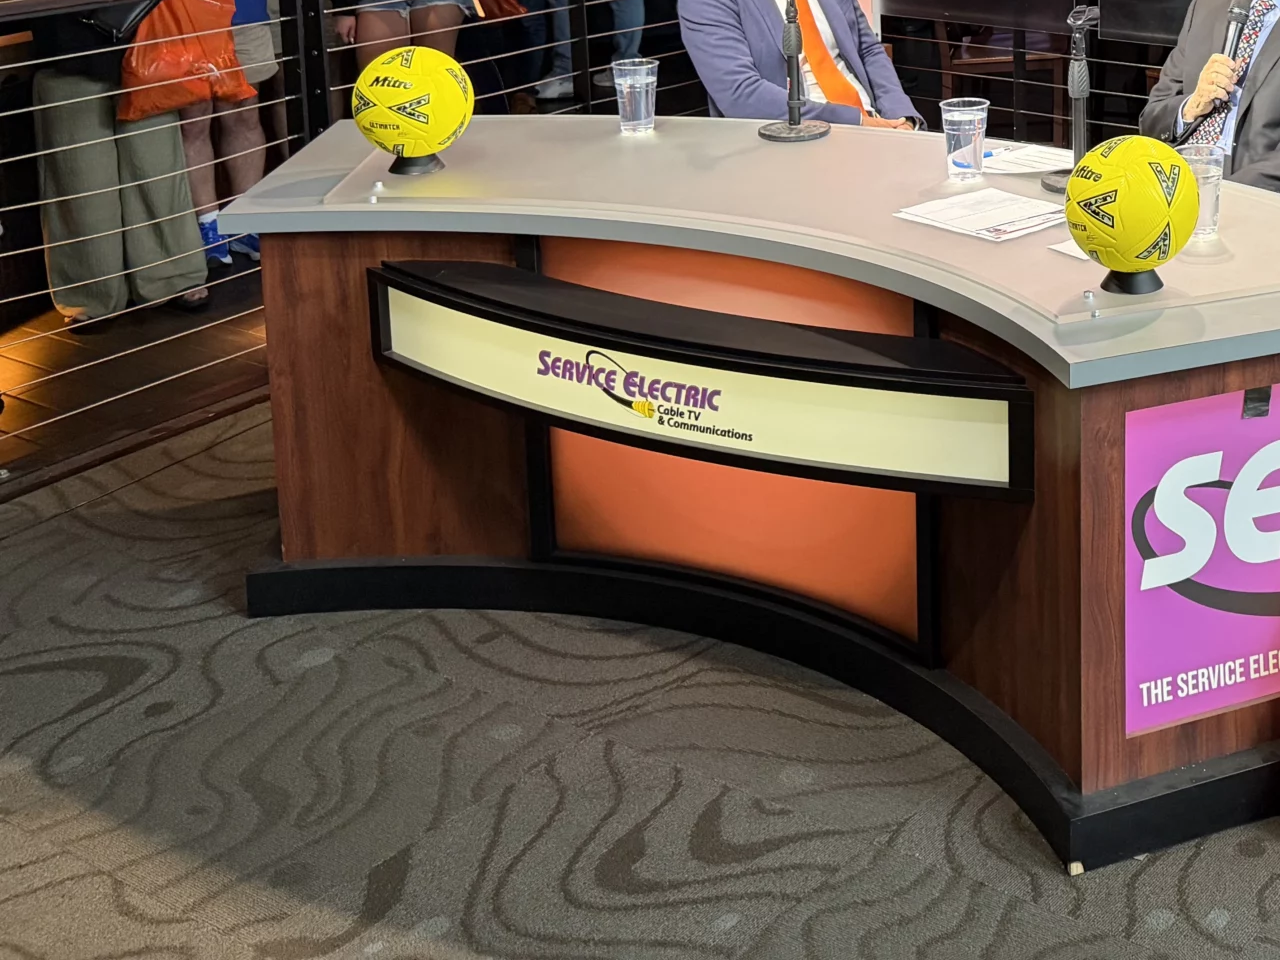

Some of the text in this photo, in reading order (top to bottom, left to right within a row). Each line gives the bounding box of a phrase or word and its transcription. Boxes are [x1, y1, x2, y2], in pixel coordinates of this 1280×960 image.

[368, 75, 414, 90] Mitre
[369, 121, 400, 131] ULTIMATCH
[657, 404, 702, 422] Cable TV
[657, 415, 754, 442] & Communications
[1138, 676, 1174, 707] THE
[1176, 657, 1246, 699] SERVICE
